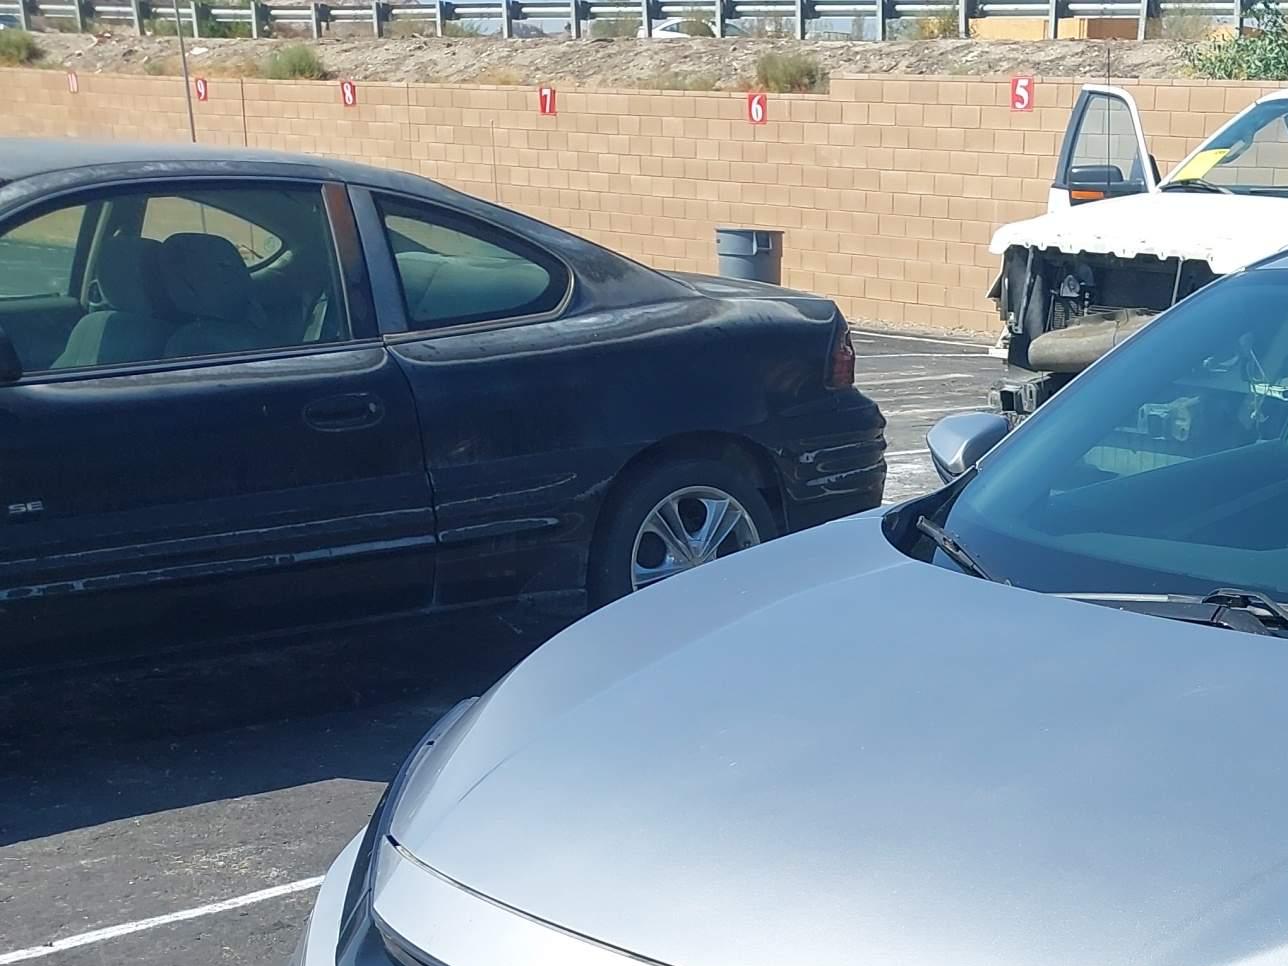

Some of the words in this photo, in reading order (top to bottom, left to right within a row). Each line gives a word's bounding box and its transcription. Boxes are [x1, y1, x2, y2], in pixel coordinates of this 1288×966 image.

[196, 80, 206, 100] 9
[343, 83, 354, 104] 8
[541, 88, 552, 113] 7
[1015, 78, 1030, 109] 5
[751, 95, 764, 122] 6
[8, 500, 44, 514] SE
